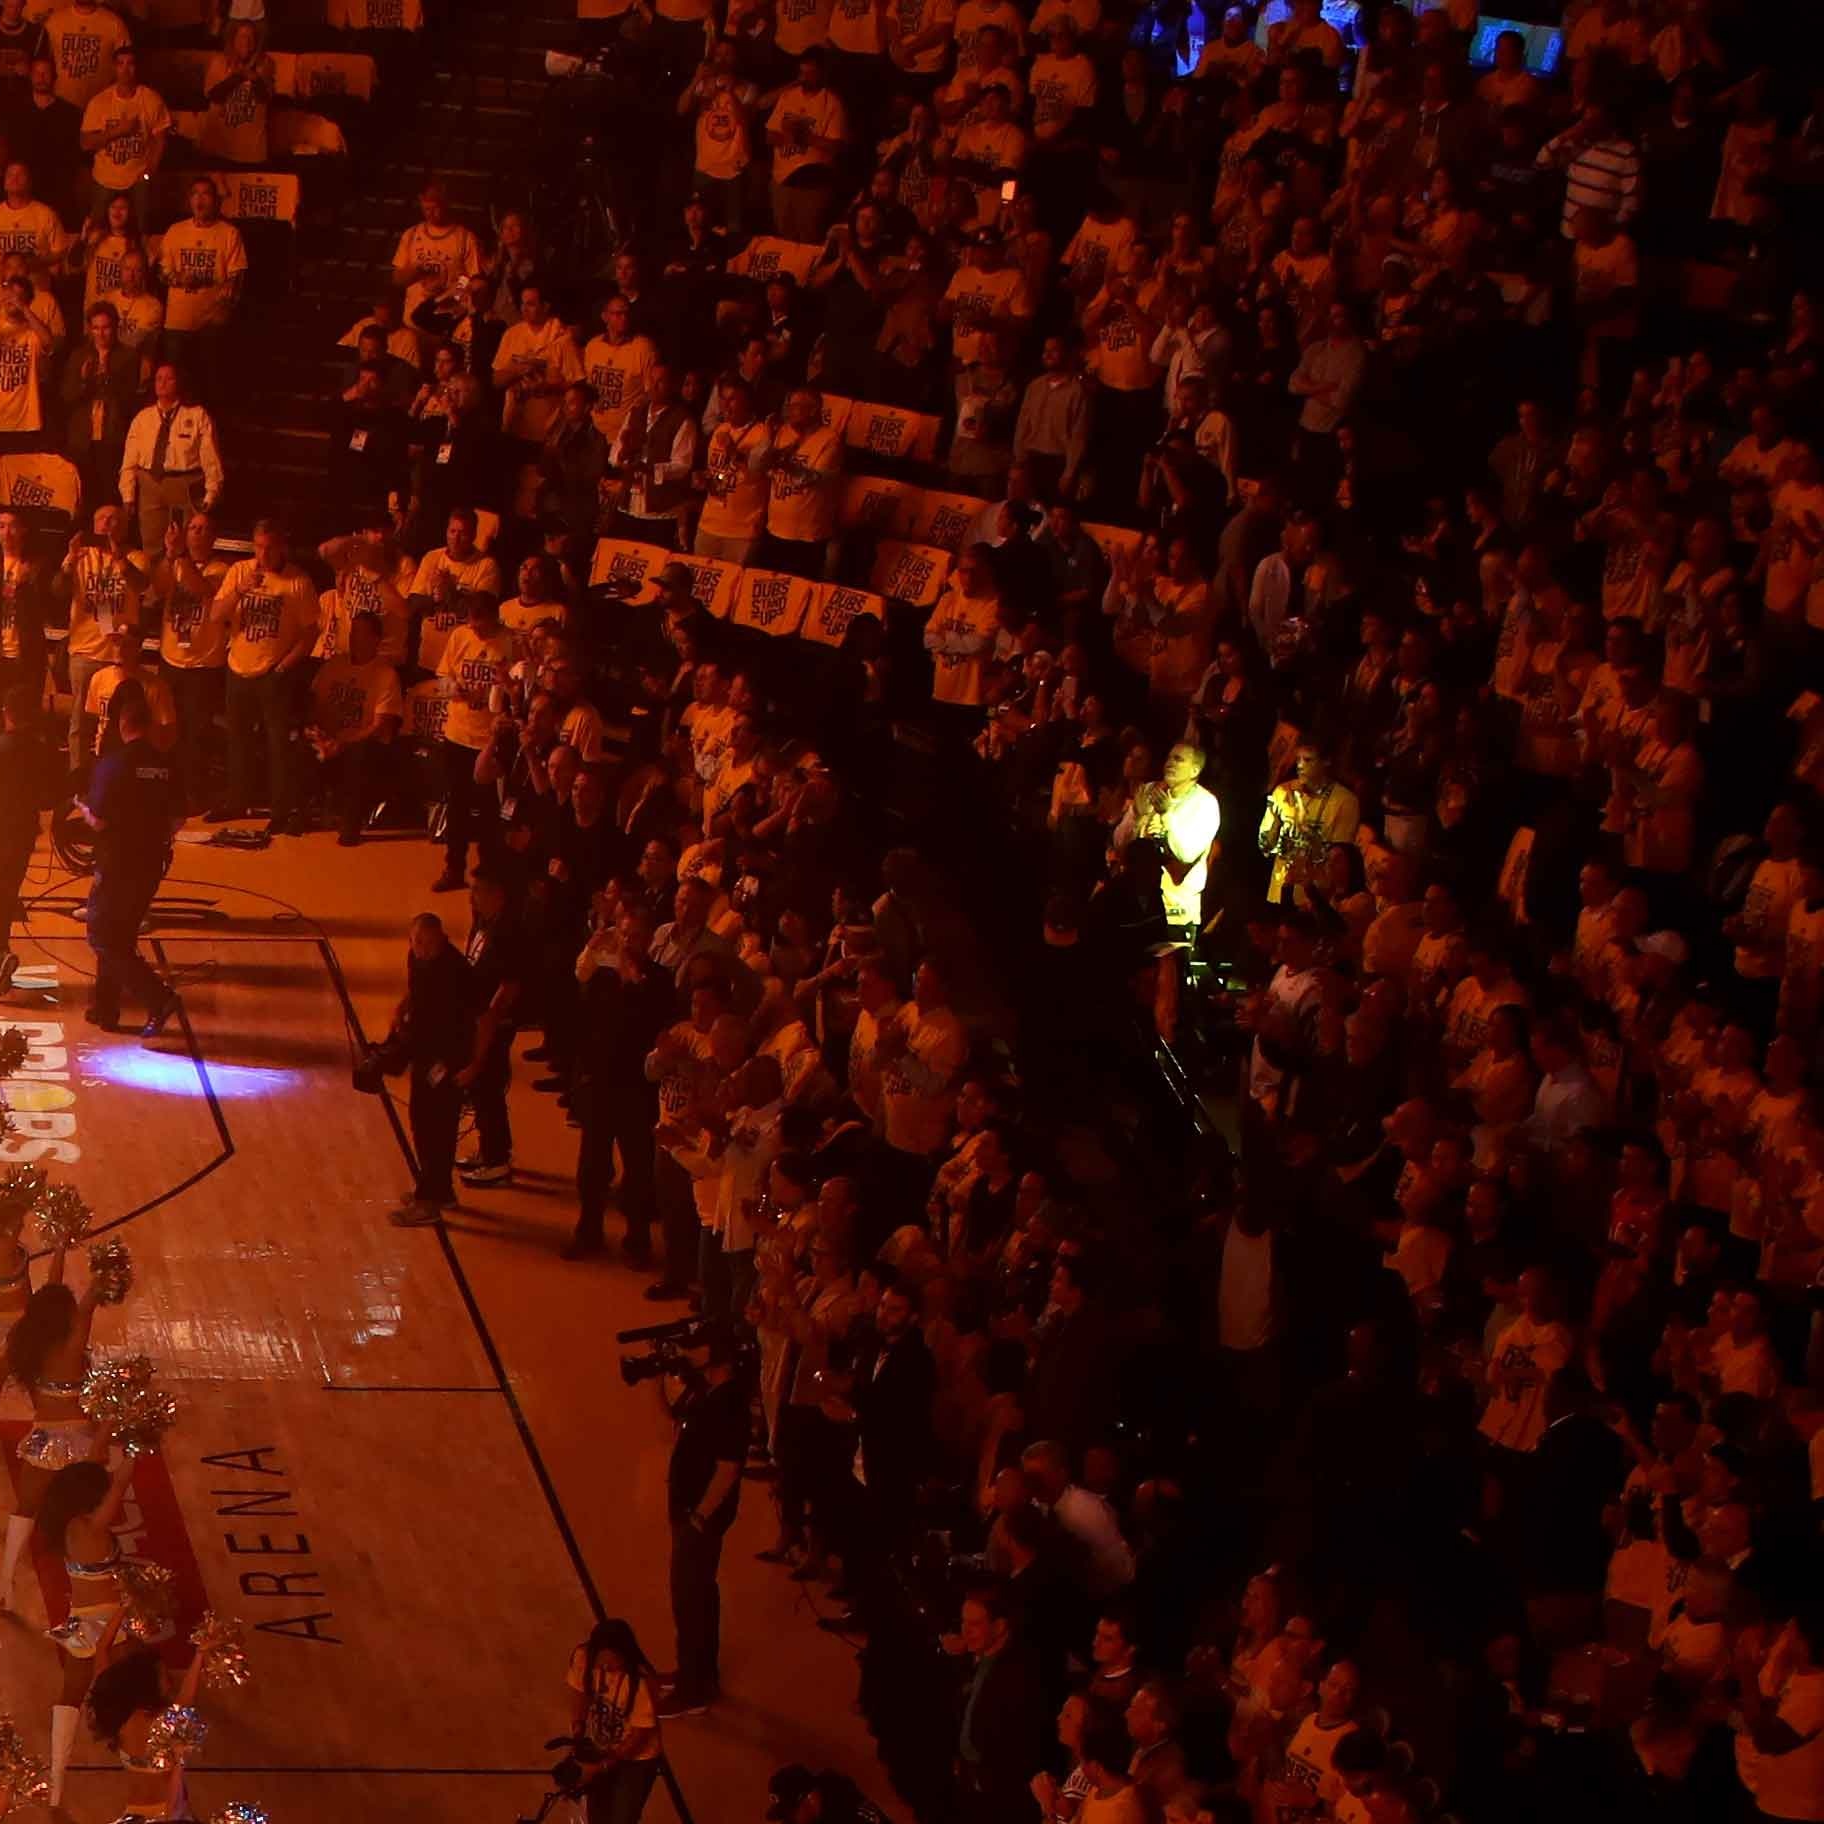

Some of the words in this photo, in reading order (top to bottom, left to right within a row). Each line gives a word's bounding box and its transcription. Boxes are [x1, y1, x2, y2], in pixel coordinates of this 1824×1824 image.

[239, 185, 279, 204] DUBS
[752, 580, 790, 601] DUBS
[201, 1447, 344, 1645] ARENA
